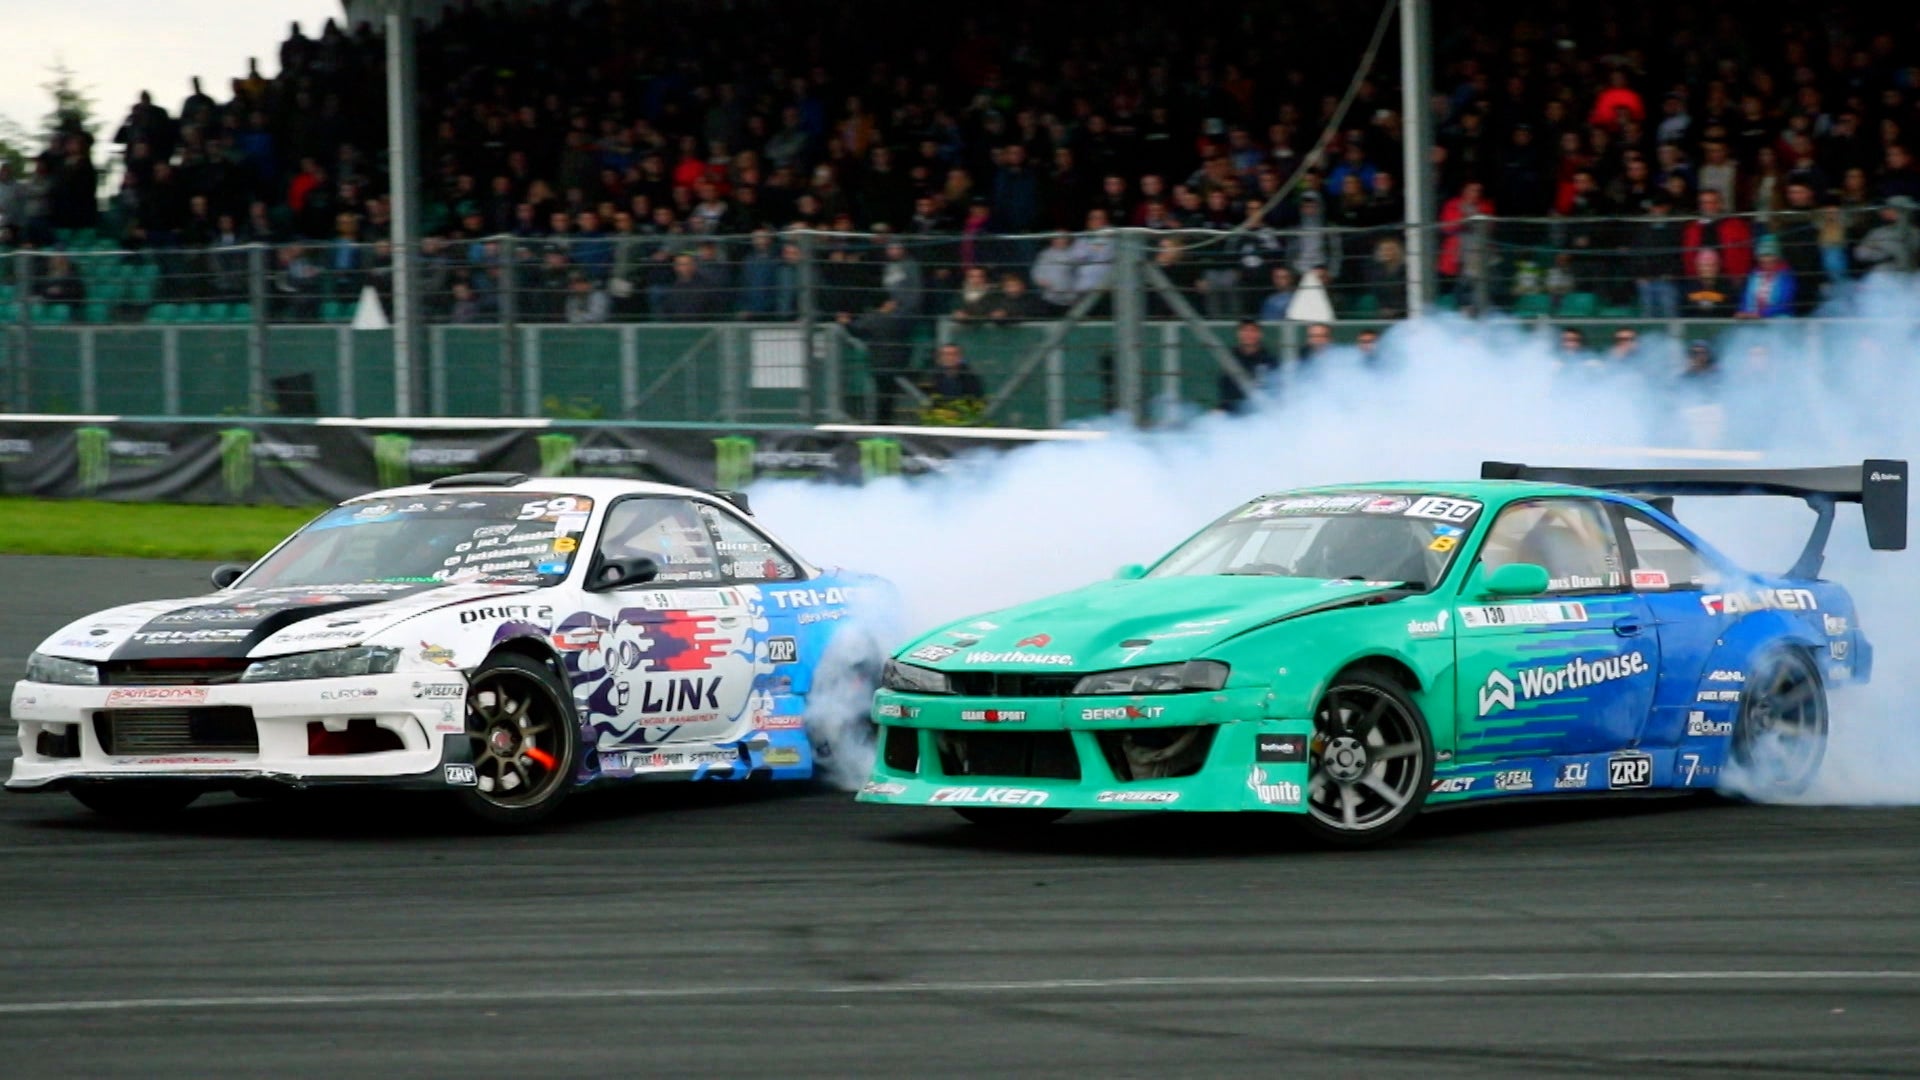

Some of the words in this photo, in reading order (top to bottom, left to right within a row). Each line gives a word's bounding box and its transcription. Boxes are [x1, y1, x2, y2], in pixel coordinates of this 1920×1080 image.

[517, 498, 576, 520] 59
[1421, 499, 1474, 519] 130
[553, 537, 577, 553] B
[1428, 536, 1459, 552] B
[1701, 589, 1818, 616] FALKEN
[459, 605, 531, 625] DRIFT
[537, 605, 553, 619] 2
[1482, 607, 1505, 624] 130
[769, 641, 794, 660] ZRP
[1518, 651, 1649, 700] Worthouse.
[641, 676, 724, 714] LINK
[447, 767, 473, 781] ZRP
[1508, 771, 1532, 784] FEAL
[1612, 763, 1649, 784] ZRP
[929, 787, 1050, 804] FALKEN
